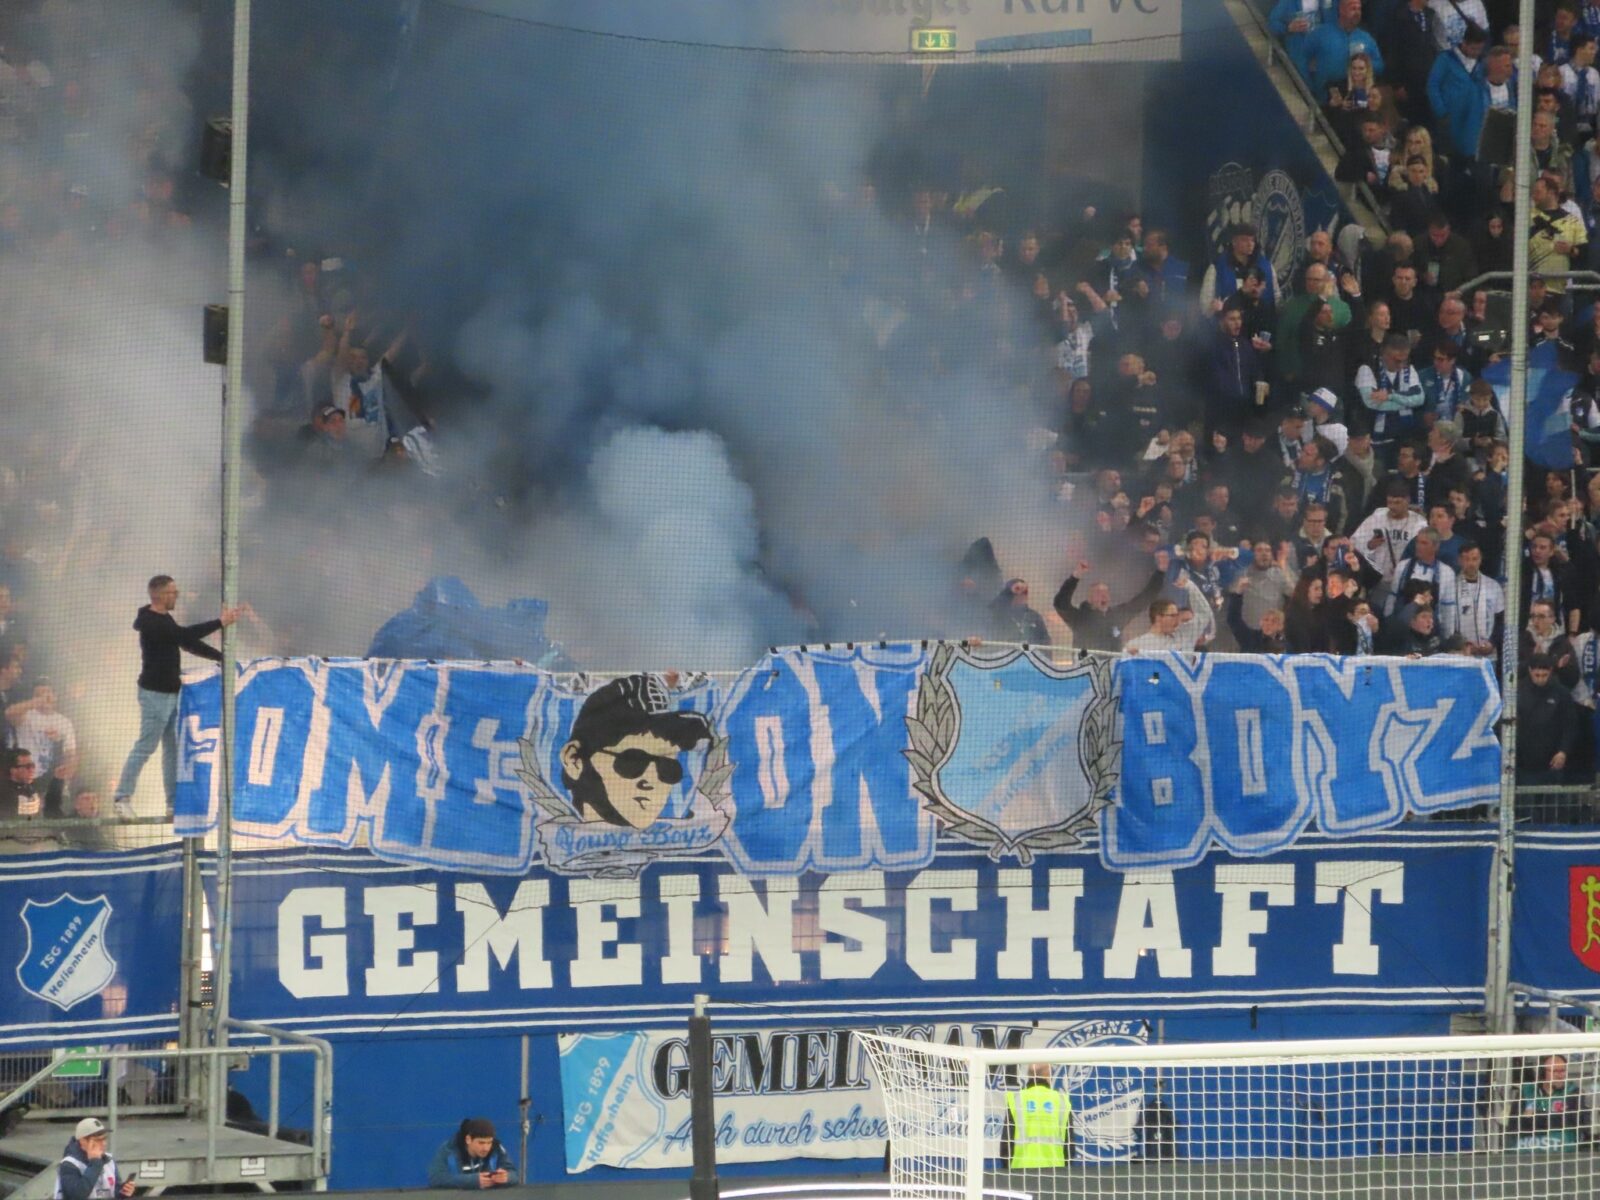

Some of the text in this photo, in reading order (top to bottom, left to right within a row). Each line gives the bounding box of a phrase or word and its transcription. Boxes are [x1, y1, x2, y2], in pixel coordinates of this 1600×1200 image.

[1100, 651, 1502, 872] BOYZ
[40, 915, 83, 969] TSG 1899
[278, 860, 1405, 999] GEMEINSCHAFT
[568, 1056, 612, 1134] TSG 1899
[664, 1111, 739, 1153] Ah
[743, 1111, 813, 1146] durch
